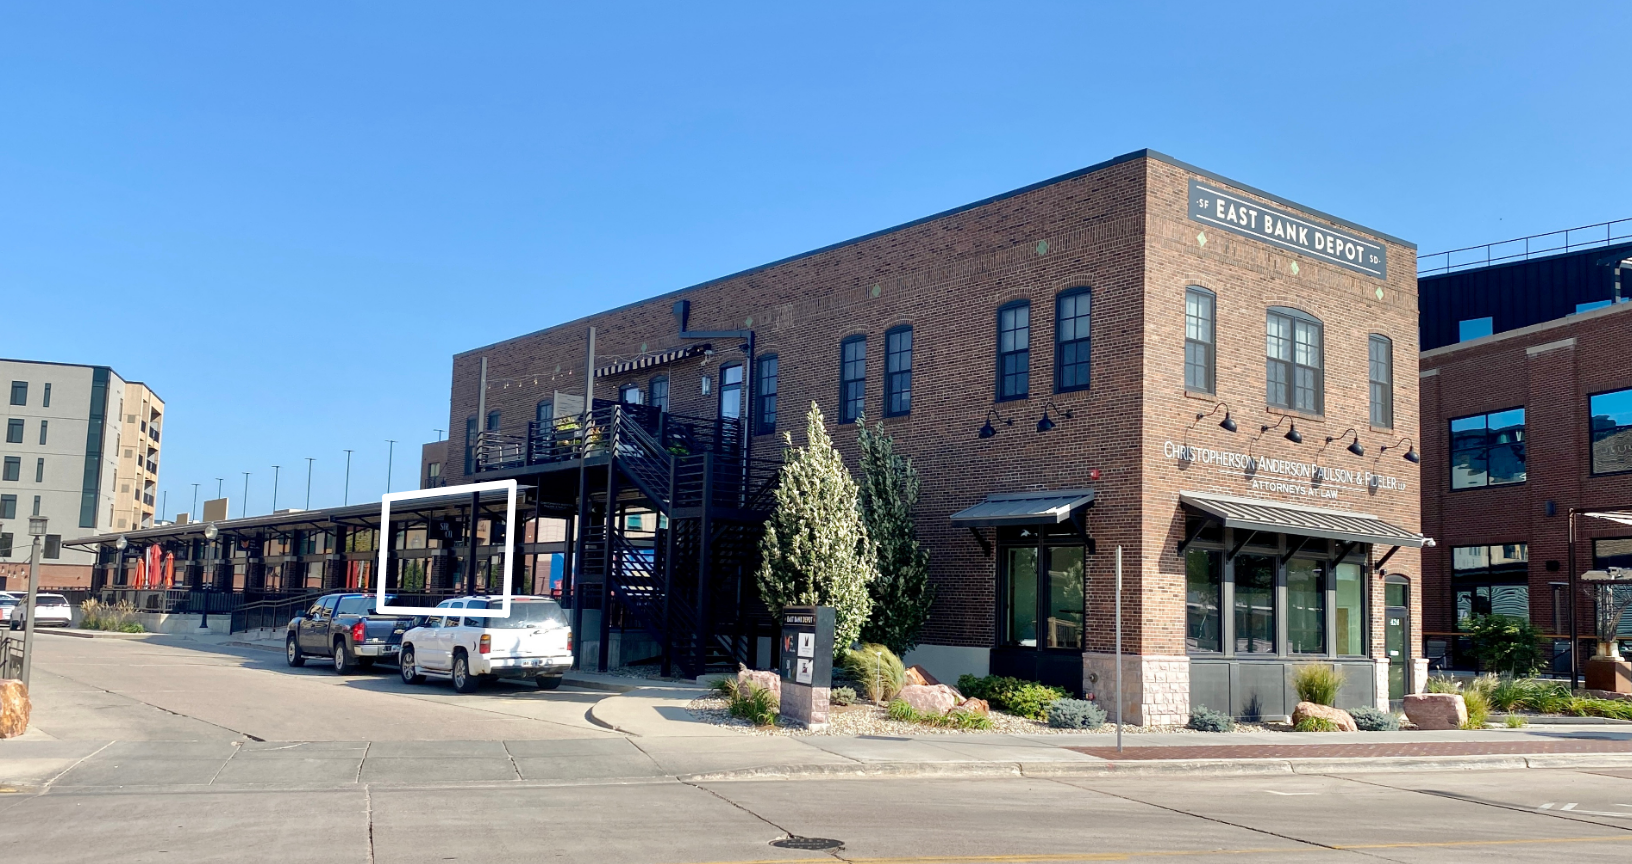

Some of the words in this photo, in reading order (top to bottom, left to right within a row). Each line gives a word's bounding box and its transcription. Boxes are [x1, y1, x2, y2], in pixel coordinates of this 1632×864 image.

[1216, 199, 1258, 229] EAST
[1264, 215, 1309, 246] BANK
[1315, 231, 1364, 263] DEPOT
[1164, 440, 1255, 470] CHRISTOPHERSON
[1258, 455, 1310, 478] ANDERSON
[1311, 463, 1353, 484] PAULSON
[1355, 471, 1363, 485] &
[1252, 479, 1306, 495] ATTORNEYS
[1307, 487, 1319, 497] AT
[1320, 488, 1339, 499] LAW
